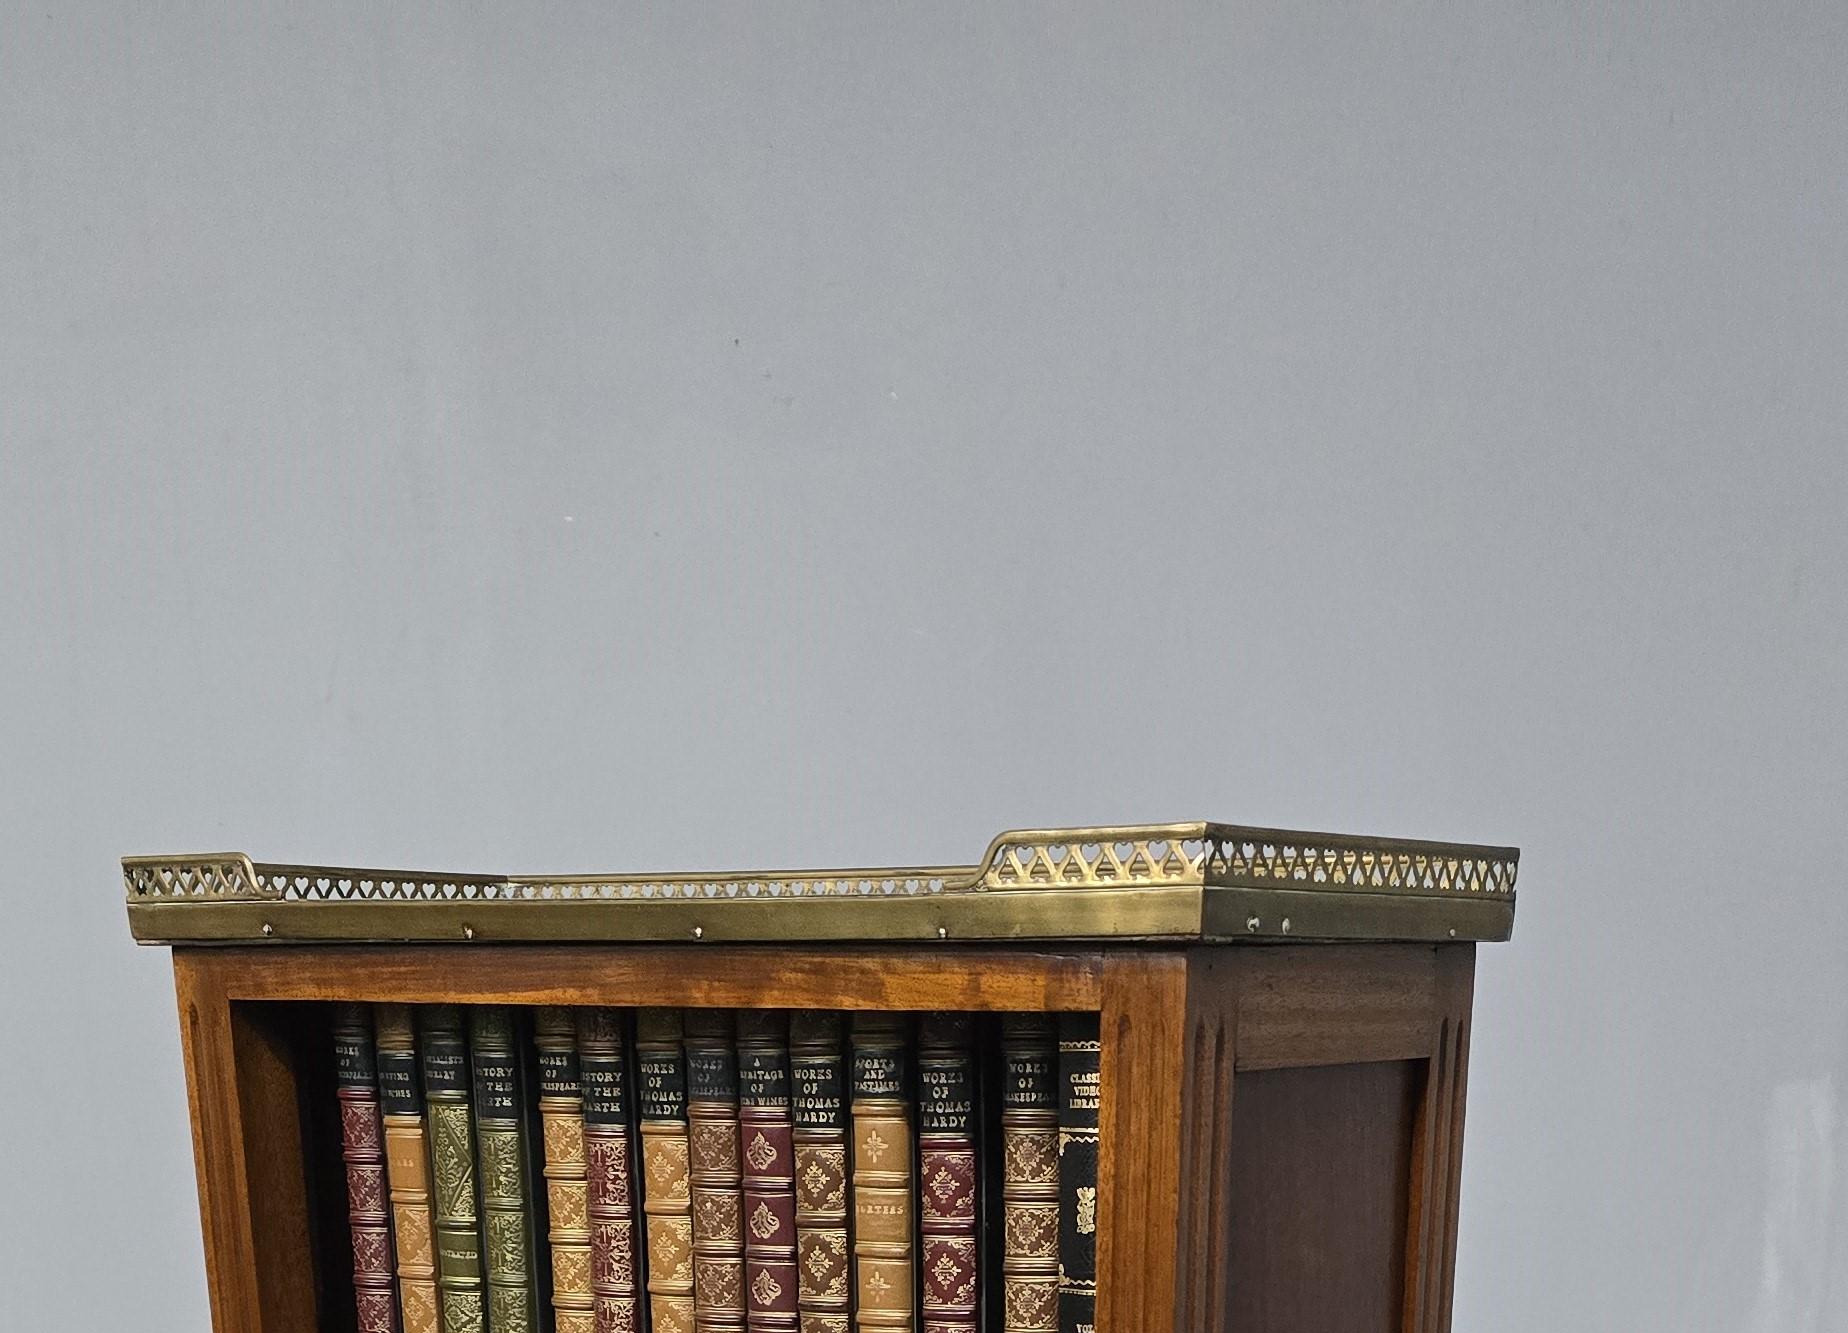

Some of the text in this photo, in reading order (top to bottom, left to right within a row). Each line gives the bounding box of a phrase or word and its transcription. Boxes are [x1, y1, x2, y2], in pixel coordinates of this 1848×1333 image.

[640, 1063, 675, 1074] WORKS
[793, 1069, 833, 1080] WORKS
[863, 1069, 885, 1080] AND
[649, 1076, 663, 1088] OF
[750, 1083, 764, 1093] OF
[803, 1082, 818, 1095] OF
[932, 1086, 949, 1099] OF
[640, 1090, 683, 1102] THOMAS
[793, 1097, 840, 1109] THOMAS
[920, 1101, 971, 1113] THOMAS
[642, 1104, 679, 1115] HARDY
[796, 1111, 836, 1123] HARDY
[923, 1115, 967, 1128] HARDY
